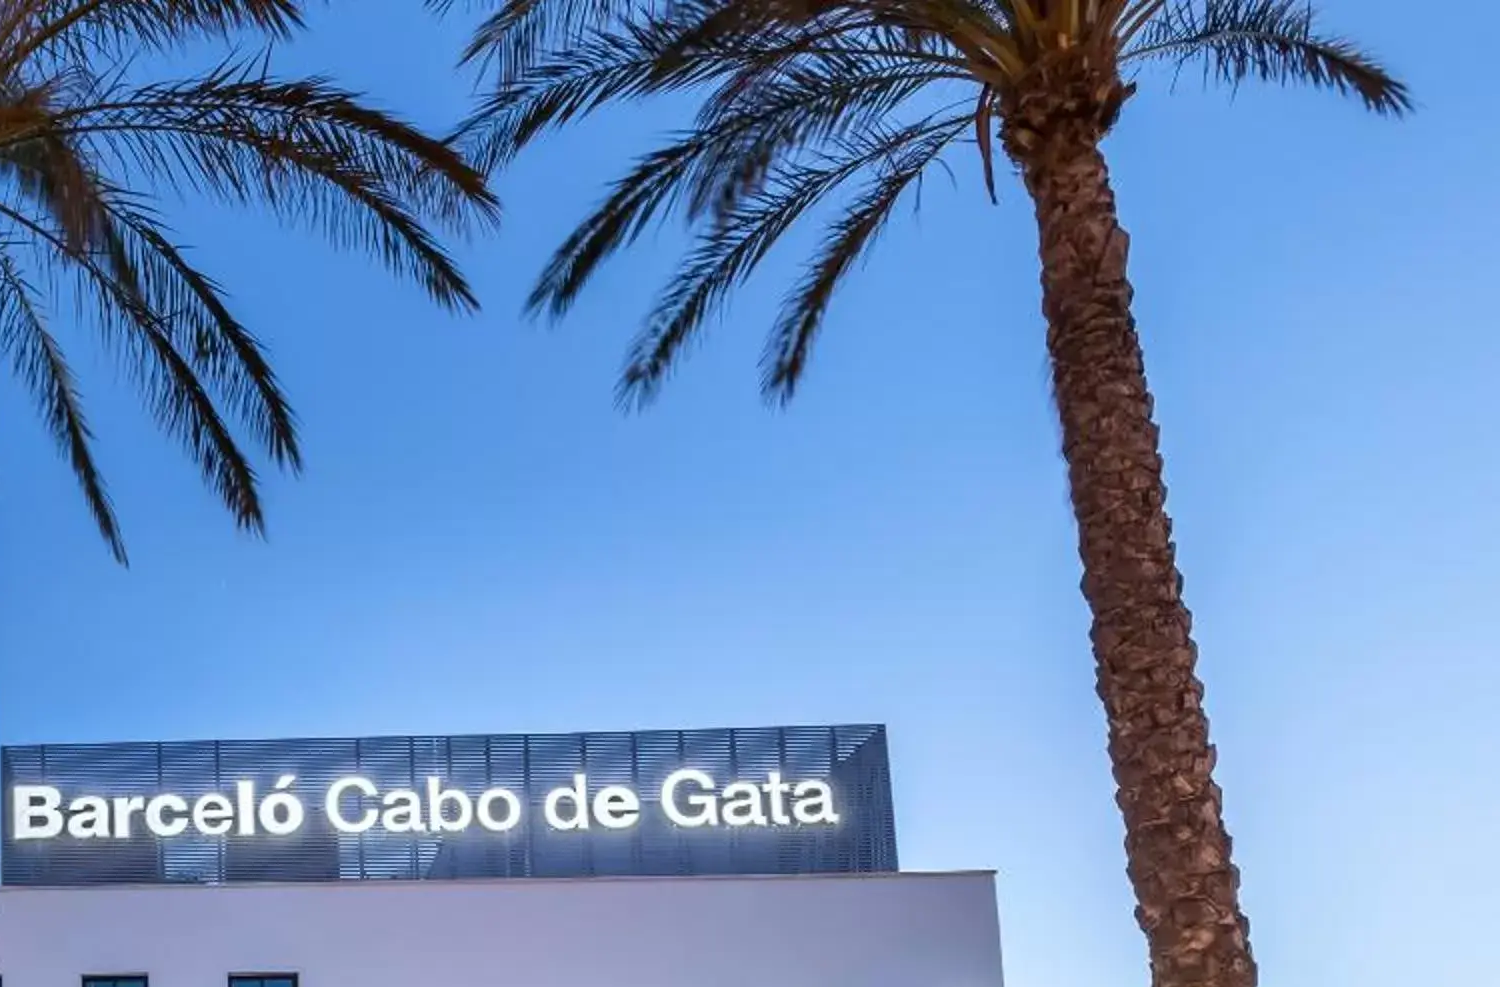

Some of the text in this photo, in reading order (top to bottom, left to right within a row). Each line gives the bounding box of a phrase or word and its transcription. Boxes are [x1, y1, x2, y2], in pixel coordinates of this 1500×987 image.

[12, 768, 839, 839] Barceló Cabo de Gata
